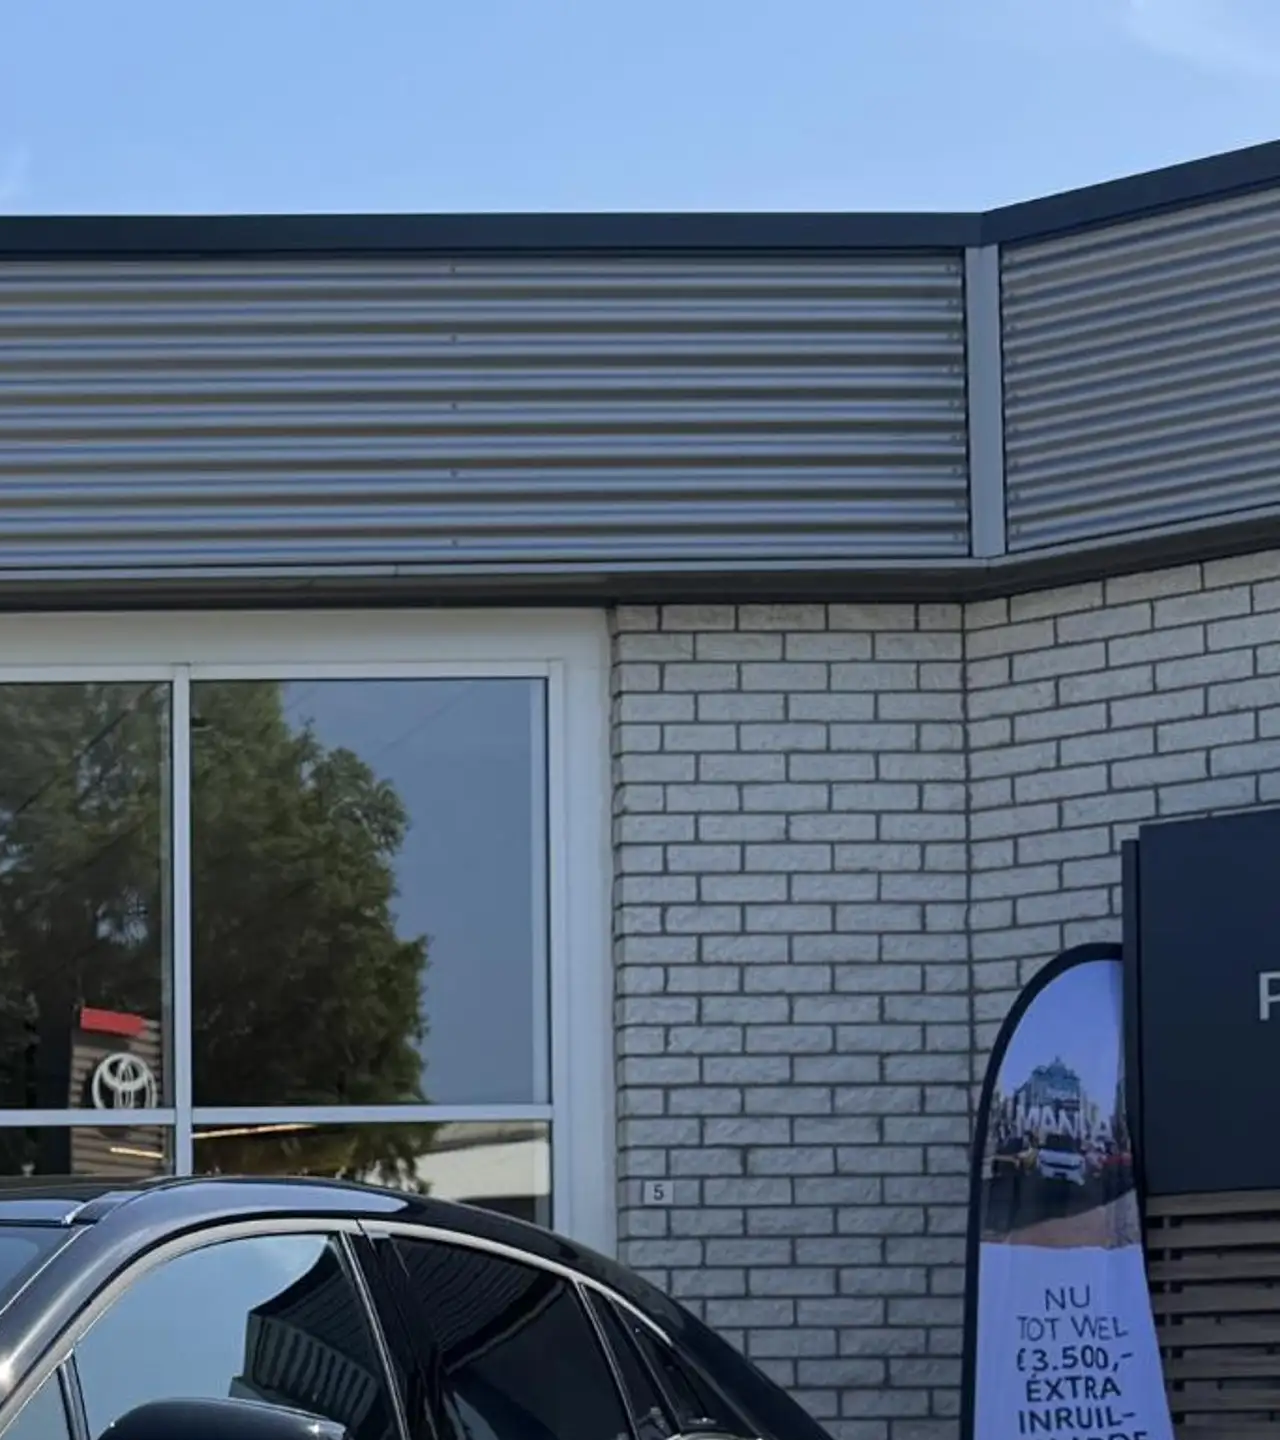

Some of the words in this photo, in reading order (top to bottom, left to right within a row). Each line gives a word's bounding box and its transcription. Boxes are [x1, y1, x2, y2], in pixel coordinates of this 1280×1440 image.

[653, 1184, 665, 1201] 5
[1045, 1285, 1090, 1312] NU
[1016, 1316, 1061, 1342] TOT
[1070, 1314, 1129, 1341] WEL
[1018, 1406, 1137, 1435] INRUIL-
